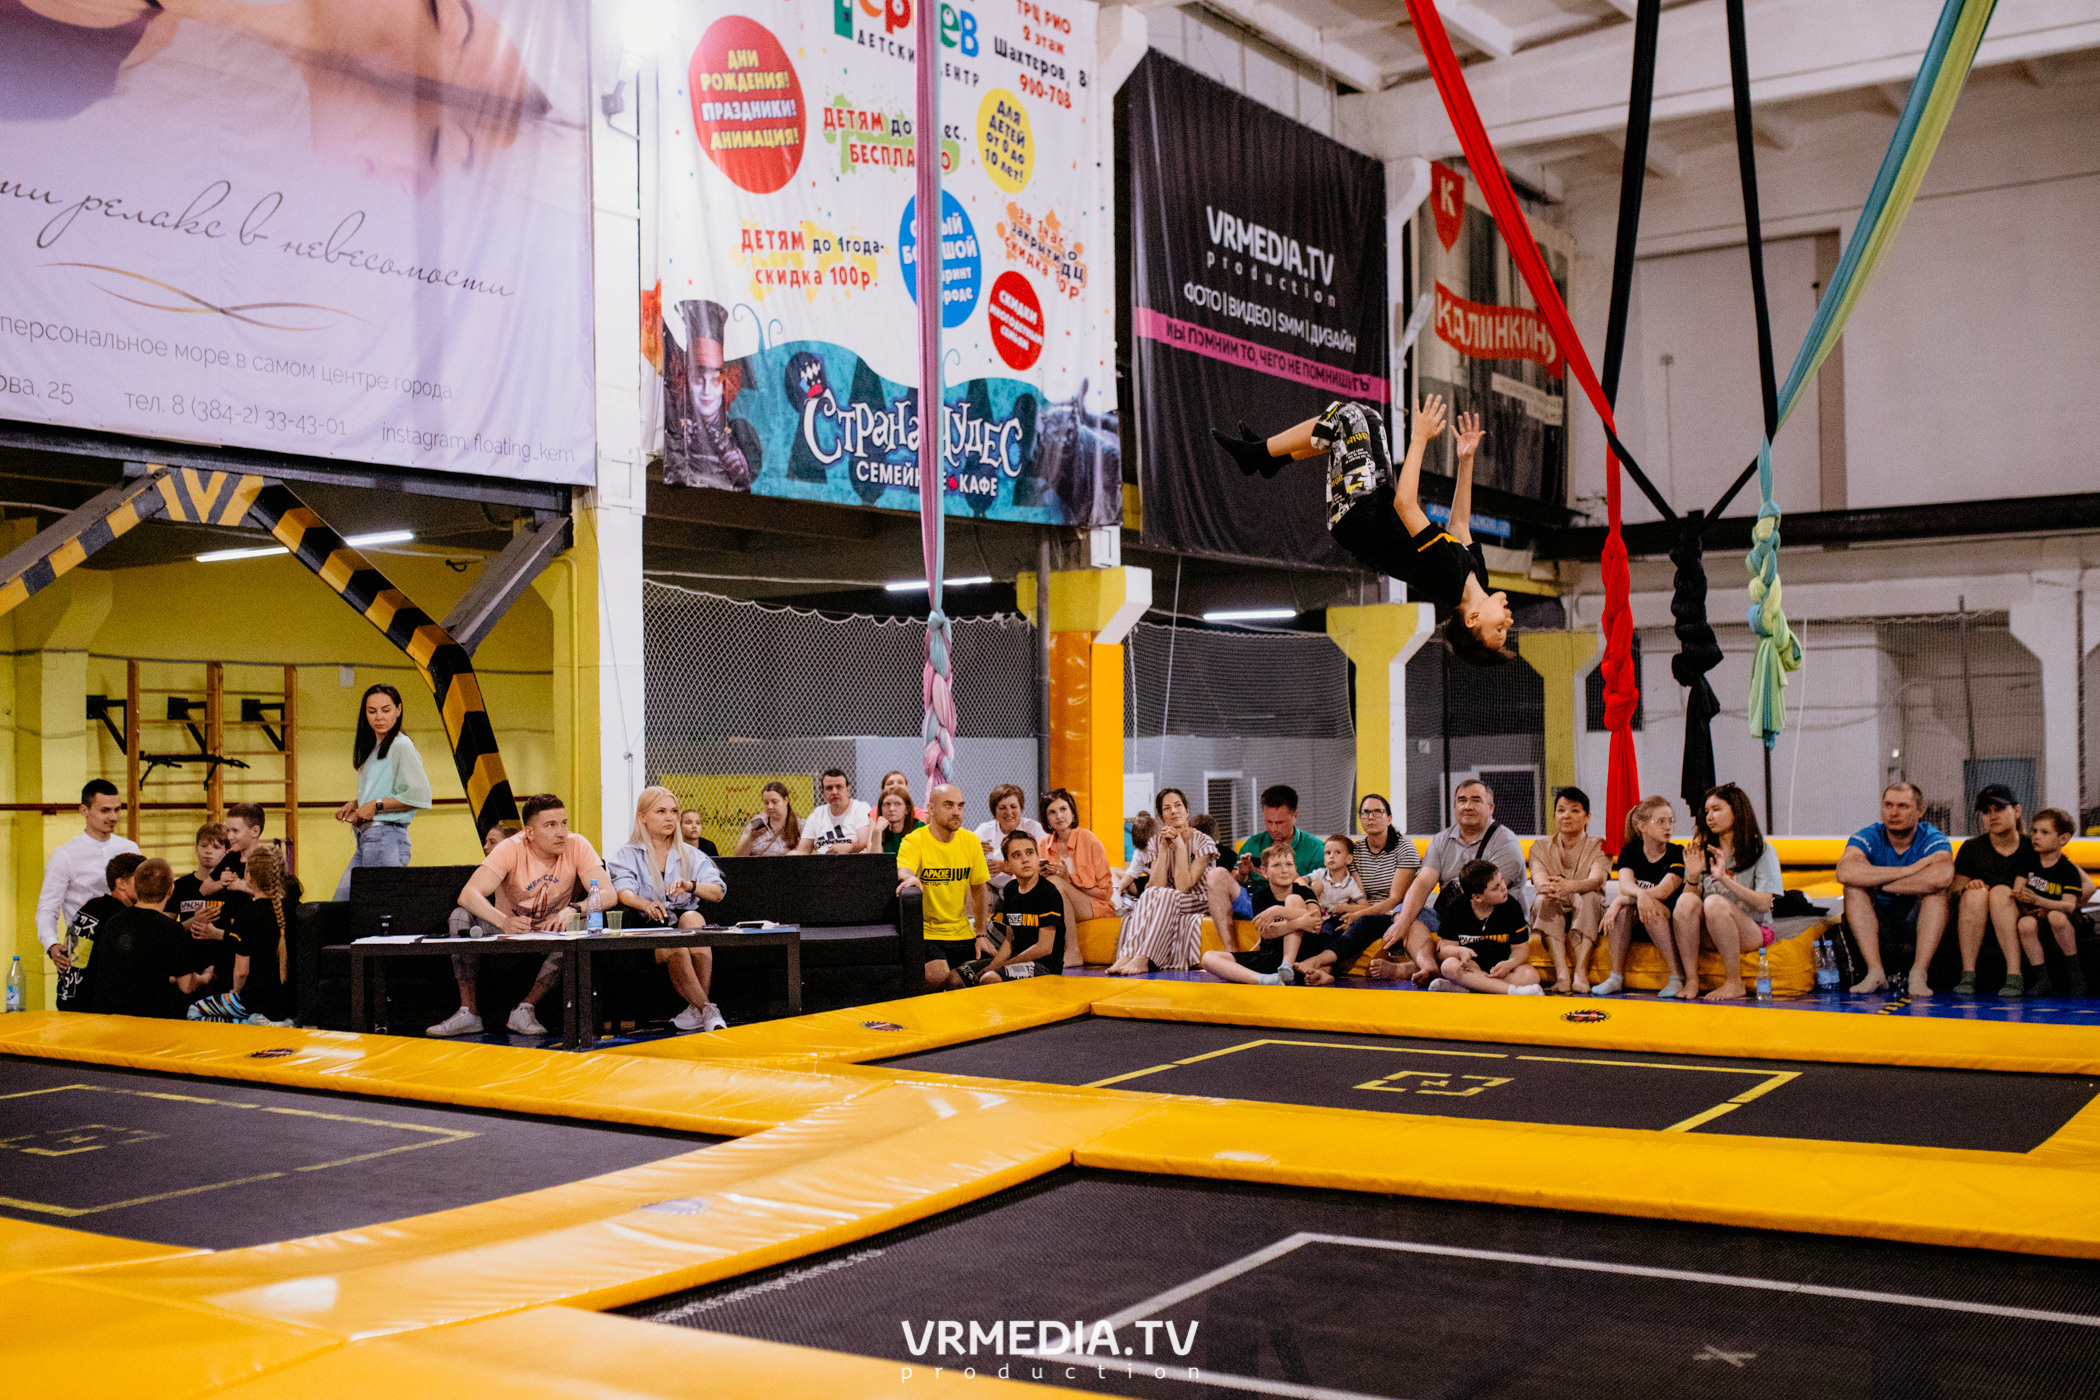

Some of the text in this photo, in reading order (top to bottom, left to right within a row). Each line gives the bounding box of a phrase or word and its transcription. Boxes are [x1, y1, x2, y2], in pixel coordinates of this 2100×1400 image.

[1044, 10, 1071, 35] РИО
[1023, 25, 1065, 56] 2 этаж
[728, 49, 760, 70] ДНИ
[857, 29, 980, 87] ДЕТСКИ ЕНТР
[700, 71, 790, 92] РОЖДЕНИЯ!
[1079, 70, 1087, 87] 8
[701, 99, 797, 121] ПРАЗДНИКИ!
[823, 107, 884, 131] ДЕТЯМ
[891, 119, 912, 137] до
[997, 100, 1020, 126] ДЛЯ
[710, 127, 799, 150] АНИМАЦИЯ!
[989, 114, 1025, 149] ДЕТЕЙ
[985, 148, 998, 165] 10
[1002, 139, 1009, 153] 0
[1441, 176, 1456, 217] К
[36, 180, 231, 249] релакс
[239, 191, 284, 246] в
[279, 210, 514, 297] невесомости
[741, 228, 805, 253] ДЕТЯМ
[813, 238, 831, 254] до
[1206, 205, 1335, 287] VRMEDIA.TV
[1004, 237, 1048, 277] скидка
[755, 266, 878, 290] скидка 100р.
[1061, 263, 1083, 283] ДЦ
[1206, 250, 1337, 308] production
[999, 289, 1038, 326] СКИДКИ
[0, 315, 453, 400] персональное море в самом центре города
[48, 381, 74, 405] 25
[124, 391, 348, 437] тел. 8 (384-2) 33-43-01
[473, 433, 576, 464] floating_kem
[959, 478, 998, 497] КАФЕ
[921, 869, 950, 882] APACHE
